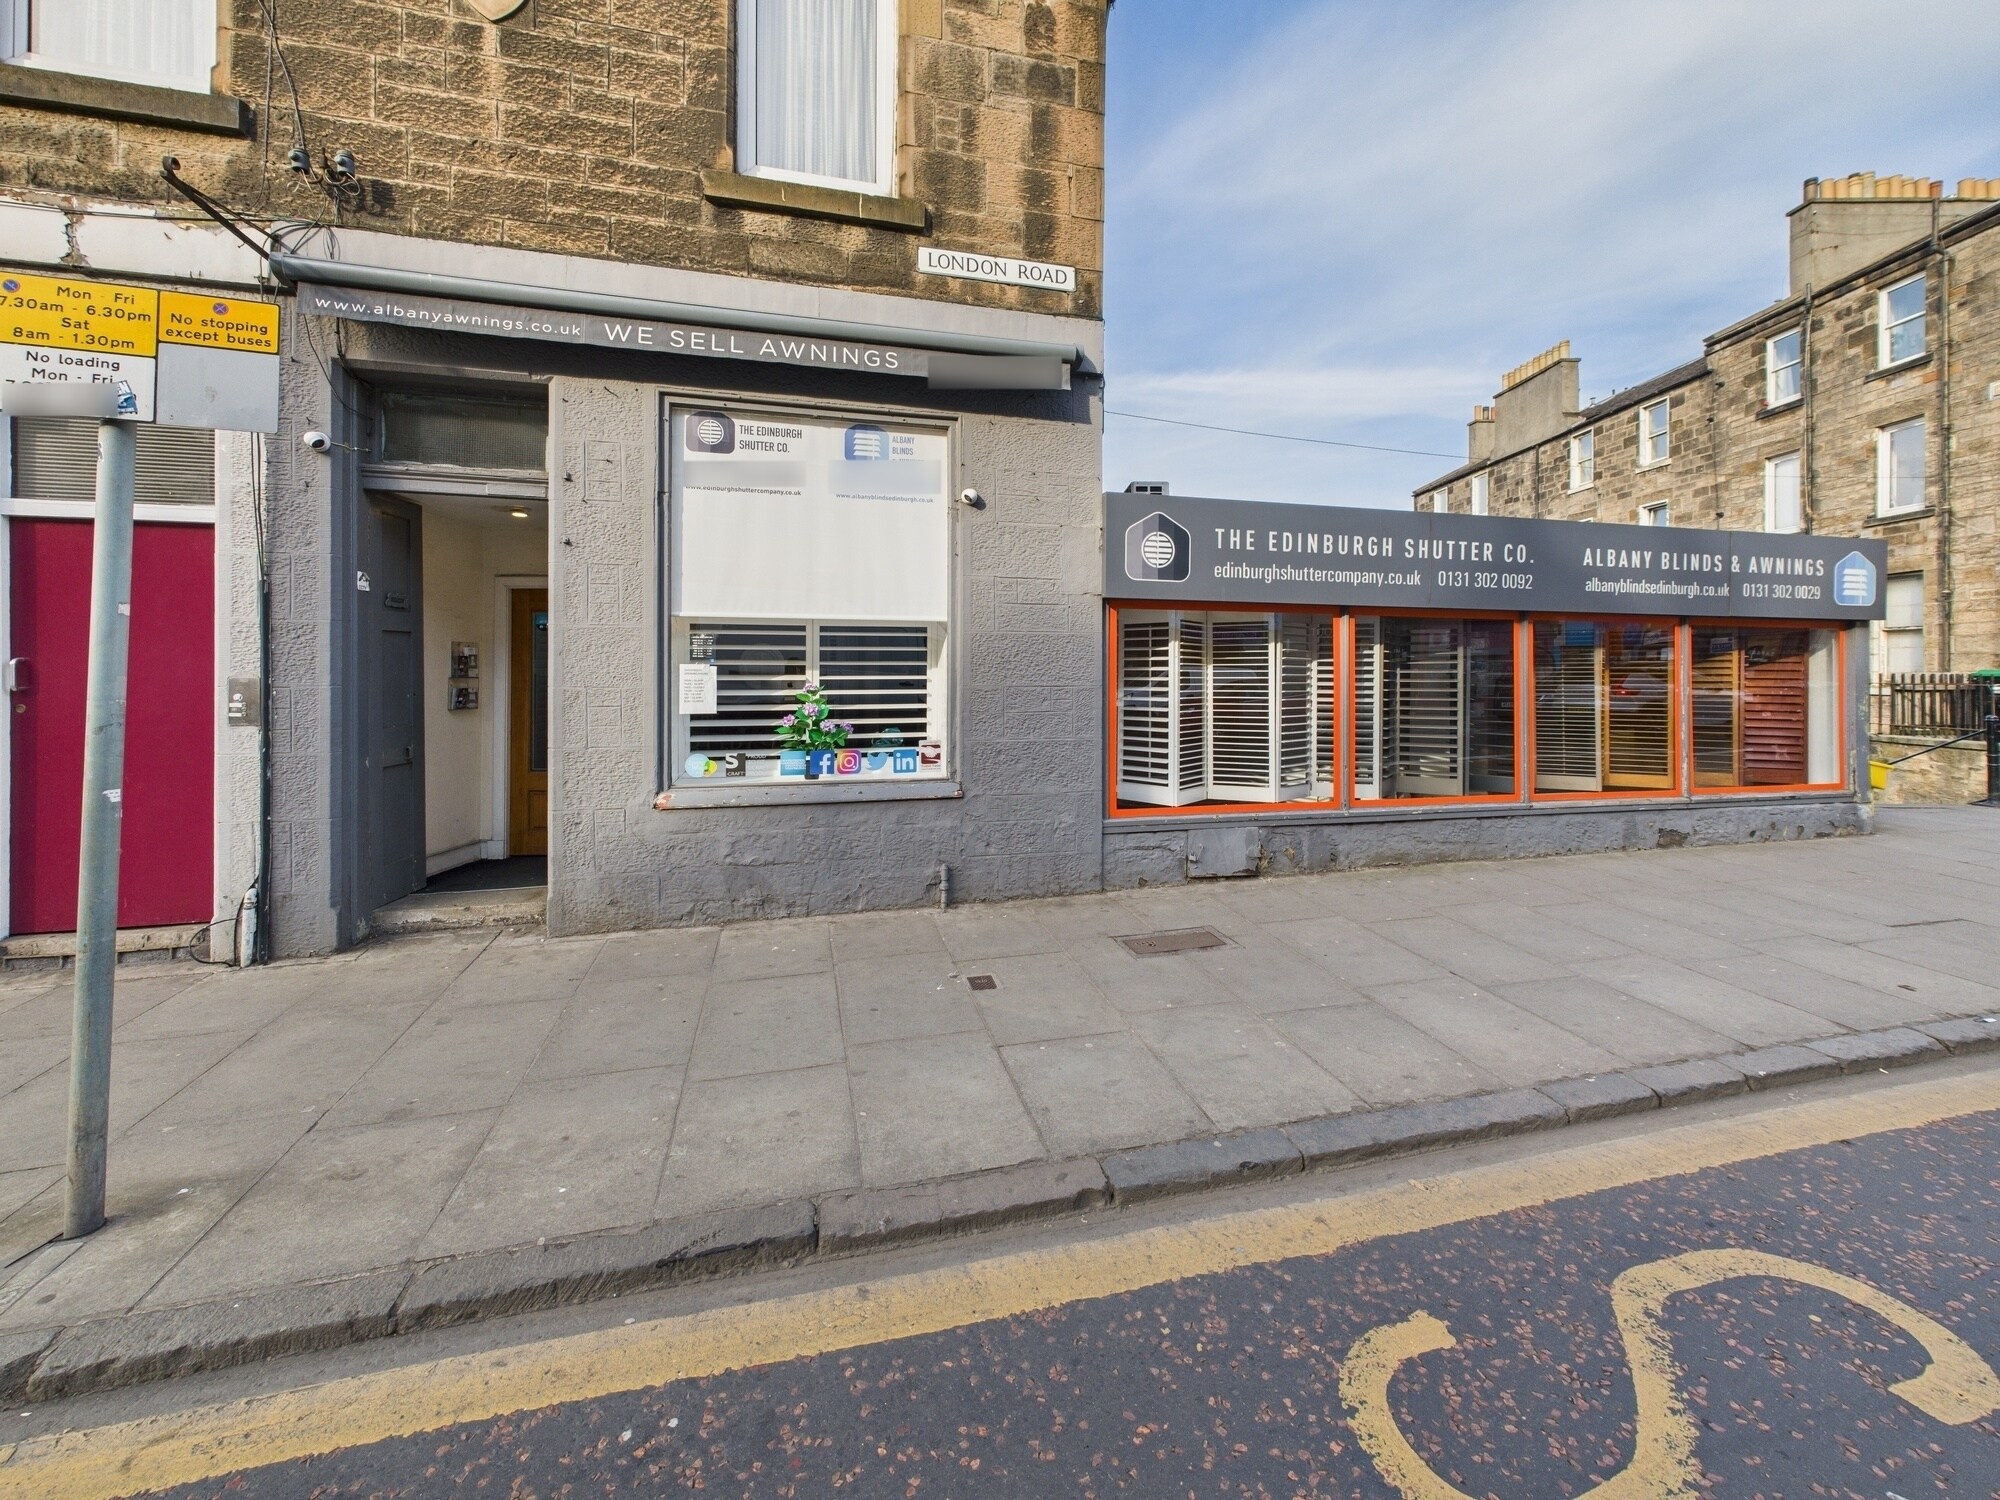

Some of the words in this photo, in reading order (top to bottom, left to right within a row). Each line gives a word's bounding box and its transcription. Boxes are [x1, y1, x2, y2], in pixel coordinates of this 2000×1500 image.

[928, 252, 1007, 277] LONDON
[1018, 264, 1068, 284] ROAD
[57, 286, 92, 300] Mon
[114, 292, 135, 305] Fri
[0, 295, 64, 312] 7.30am
[86, 305, 151, 322] 6.30pm
[315, 297, 582, 336] www.albanyawnings.co.uk
[61, 317, 90, 331] Sat
[170, 313, 193, 326] No
[201, 317, 268, 336] stopping
[13, 326, 50, 341] 8am
[73, 332, 135, 350] 1.30pm
[165, 328, 220, 344] except
[227, 332, 272, 348] buses
[604, 322, 654, 345] WE
[669, 330, 745, 354] SELL
[759, 339, 900, 370] AWNINGS
[25, 351, 50, 363] No
[59, 353, 121, 372] loading
[31, 368, 67, 381] Mon
[92, 373, 113, 384] Fri
[739, 424, 755, 437] THE
[756, 425, 803, 440] EDINBURGH
[892, 435, 915, 445] ALBANY
[739, 439, 775, 453] SHUTTER
[776, 441, 790, 453] CO.
[892, 446, 914, 456] BLINDS
[835, 492, 935, 504] www.albanyblindsedinburgh.co.uk
[1215, 528, 1256, 551] THE
[1268, 531, 1393, 558] EDINBURGH
[1404, 538, 1494, 562] SHUTTER
[1504, 543, 1535, 565] CO.
[1582, 547, 1653, 569] ALBANY
[1661, 551, 1723, 573] BLINDS
[1731, 555, 1741, 573] &
[1748, 555, 1825, 577] AWNINGS
[1214, 563, 1421, 588] edinburghshuttercompany.co.uk
[1438, 570, 1470, 588] 0131
[1474, 571, 1499, 589] 302
[1501, 573, 1534, 591] 0092
[1585, 577, 1731, 599] albanyblindsedinburgh.co.uk
[1743, 583, 1769, 599] 0131
[1772, 583, 1792, 599] 302
[1794, 585, 1822, 600] 0029
[726, 753, 739, 769] S
[896, 752, 914, 771] in
